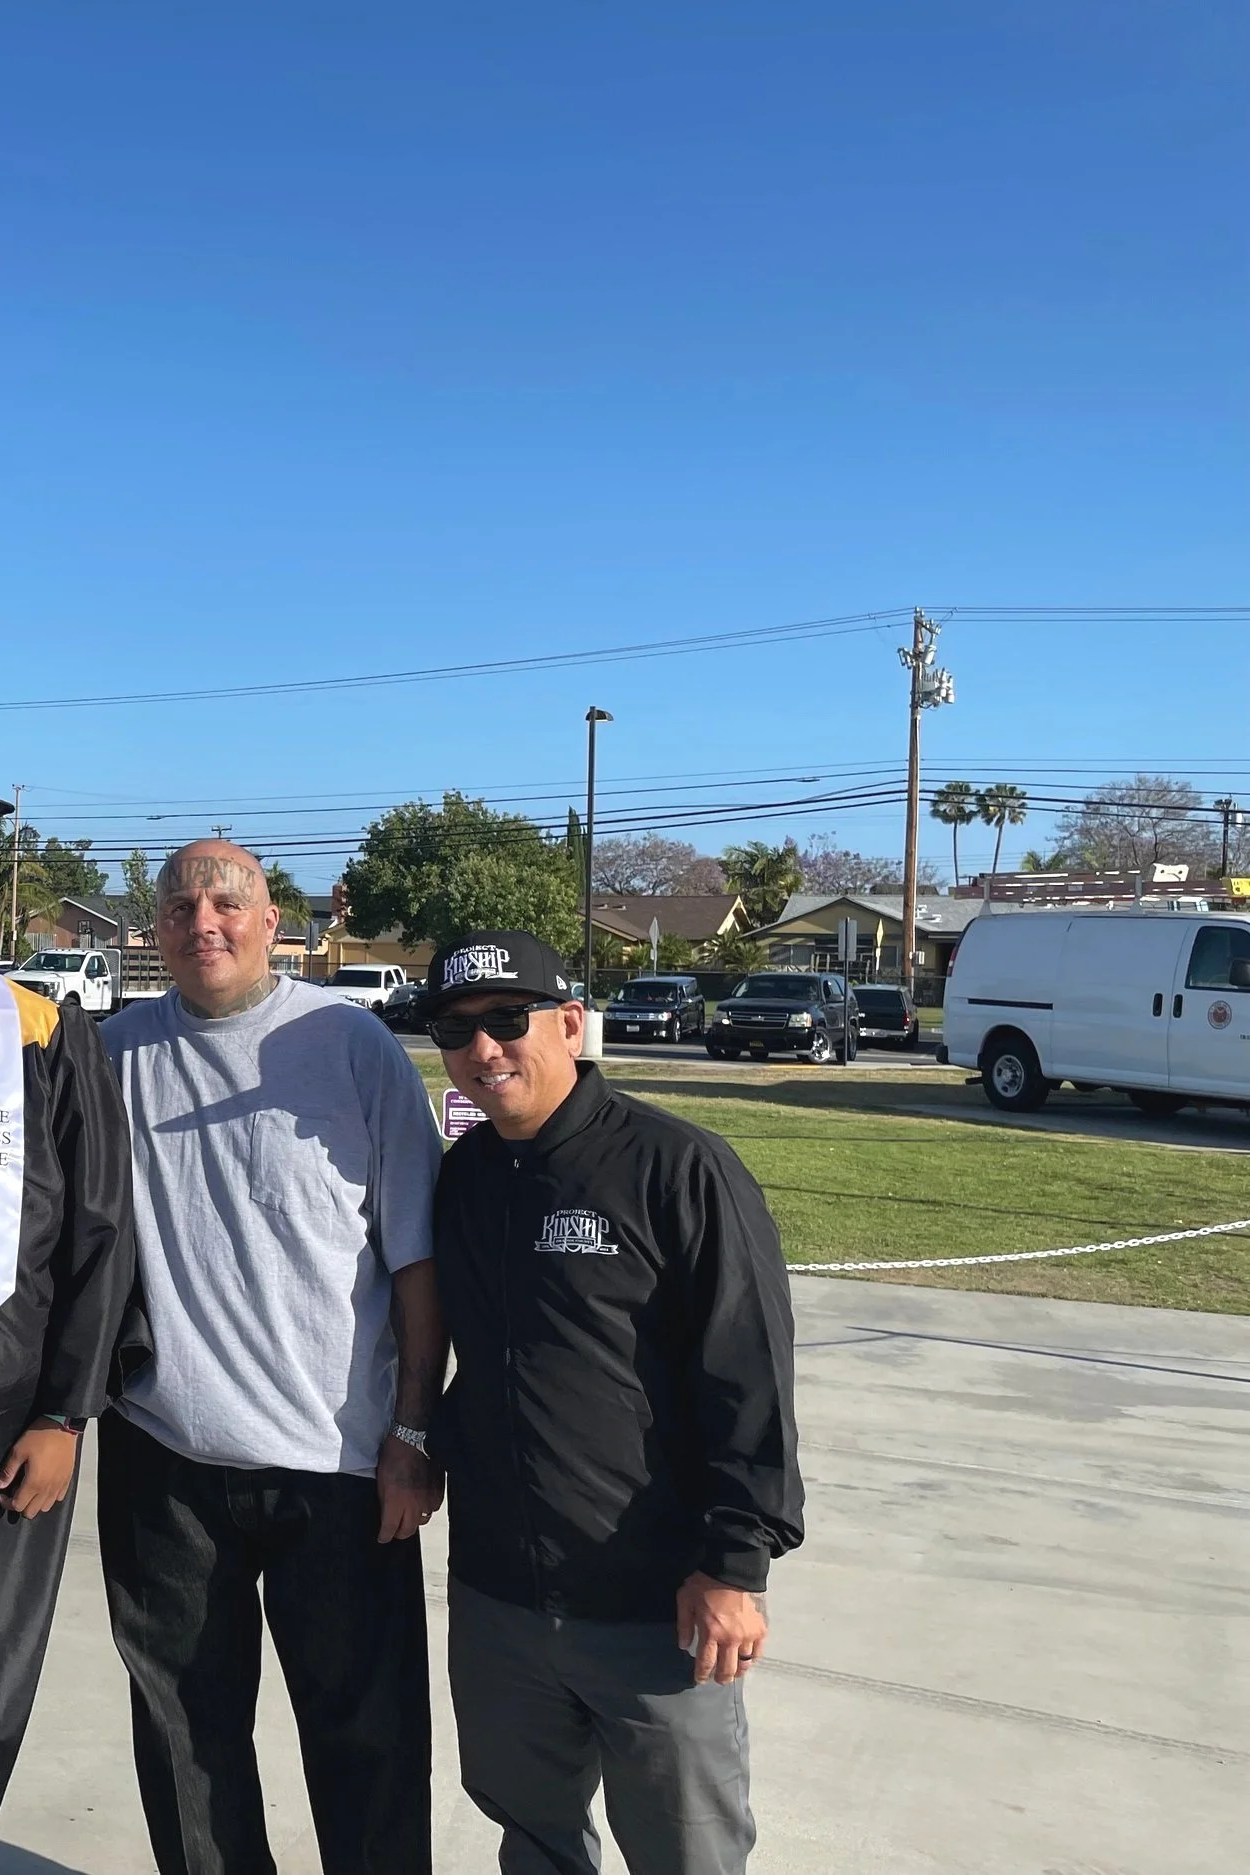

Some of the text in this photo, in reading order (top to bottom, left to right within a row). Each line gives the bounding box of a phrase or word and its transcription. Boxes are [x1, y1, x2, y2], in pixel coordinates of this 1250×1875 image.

[454, 945, 497, 955] PROJECT
[443, 949, 510, 984] KINSHIP
[556, 1209, 597, 1217] PROJECT
[542, 1213, 610, 1249] KINSHIP
